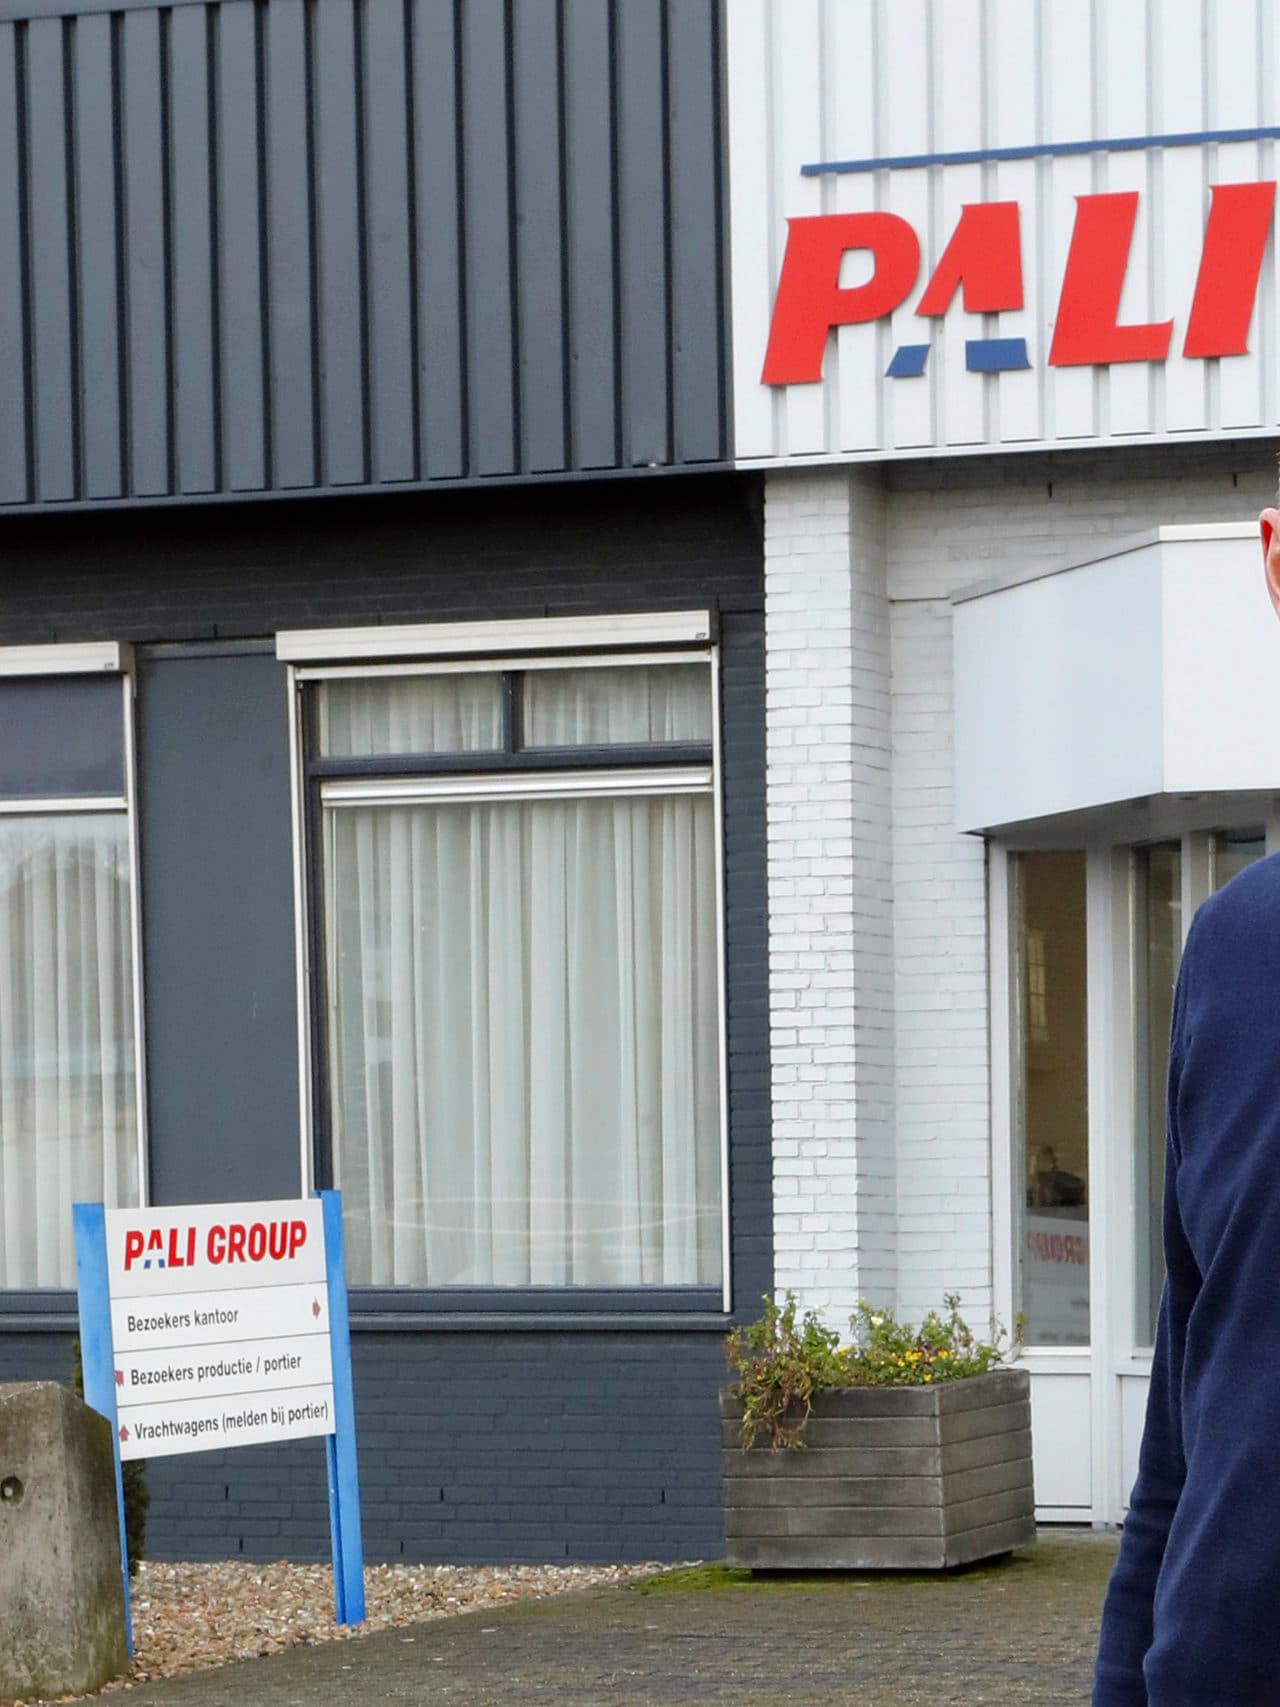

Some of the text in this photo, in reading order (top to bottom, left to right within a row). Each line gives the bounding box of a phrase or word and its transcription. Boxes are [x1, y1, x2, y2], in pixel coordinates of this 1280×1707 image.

[761, 181, 1277, 386] PALI
[124, 1220, 307, 1271] PALI GROUP
[127, 1309, 239, 1332] Bezoekers kantoor
[130, 1365, 194, 1386] Bezoekers
[197, 1357, 252, 1382] productie
[264, 1354, 302, 1375] portier
[134, 1400, 329, 1440] Vrachtwagens (melden bij portier)
